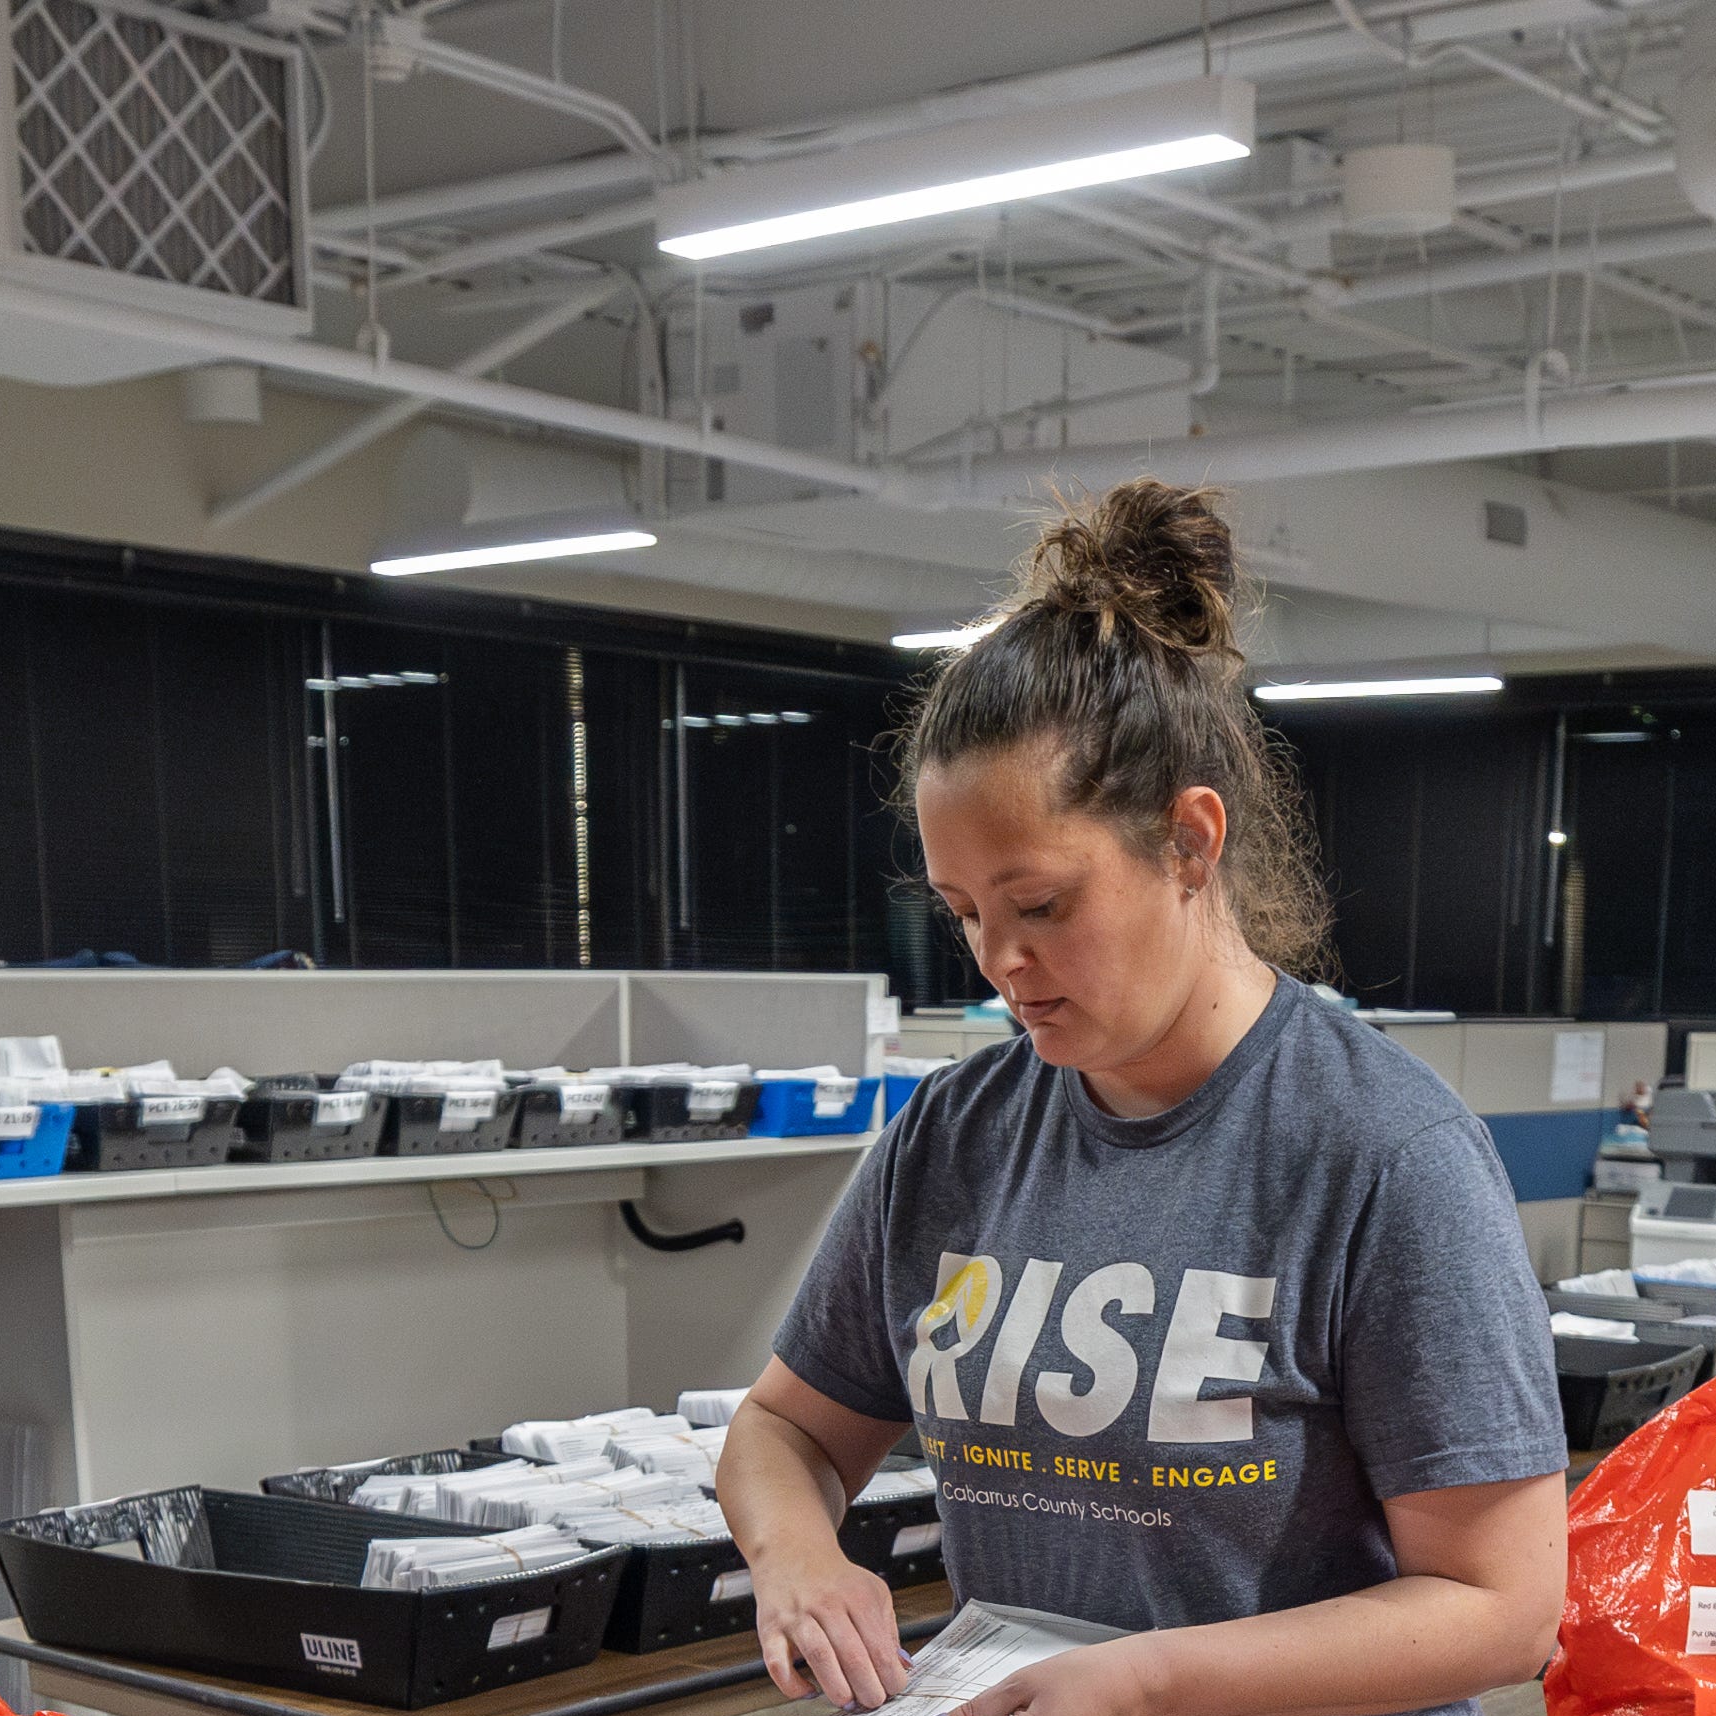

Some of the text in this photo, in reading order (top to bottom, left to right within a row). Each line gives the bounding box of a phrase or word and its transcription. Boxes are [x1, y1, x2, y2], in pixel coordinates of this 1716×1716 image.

[908, 1251, 1277, 1443] RISE
[962, 1443, 1032, 1472] IGNITE
[1054, 1456, 1120, 1483] SERVE
[1151, 1459, 1277, 1488] ENGAGE
[942, 1481, 1172, 1528] Cabarrus County Schools
[1698, 1602, 1711, 1610] Red
[305, 1638, 358, 1662] ULINE
[1691, 1630, 1703, 1638] Put
